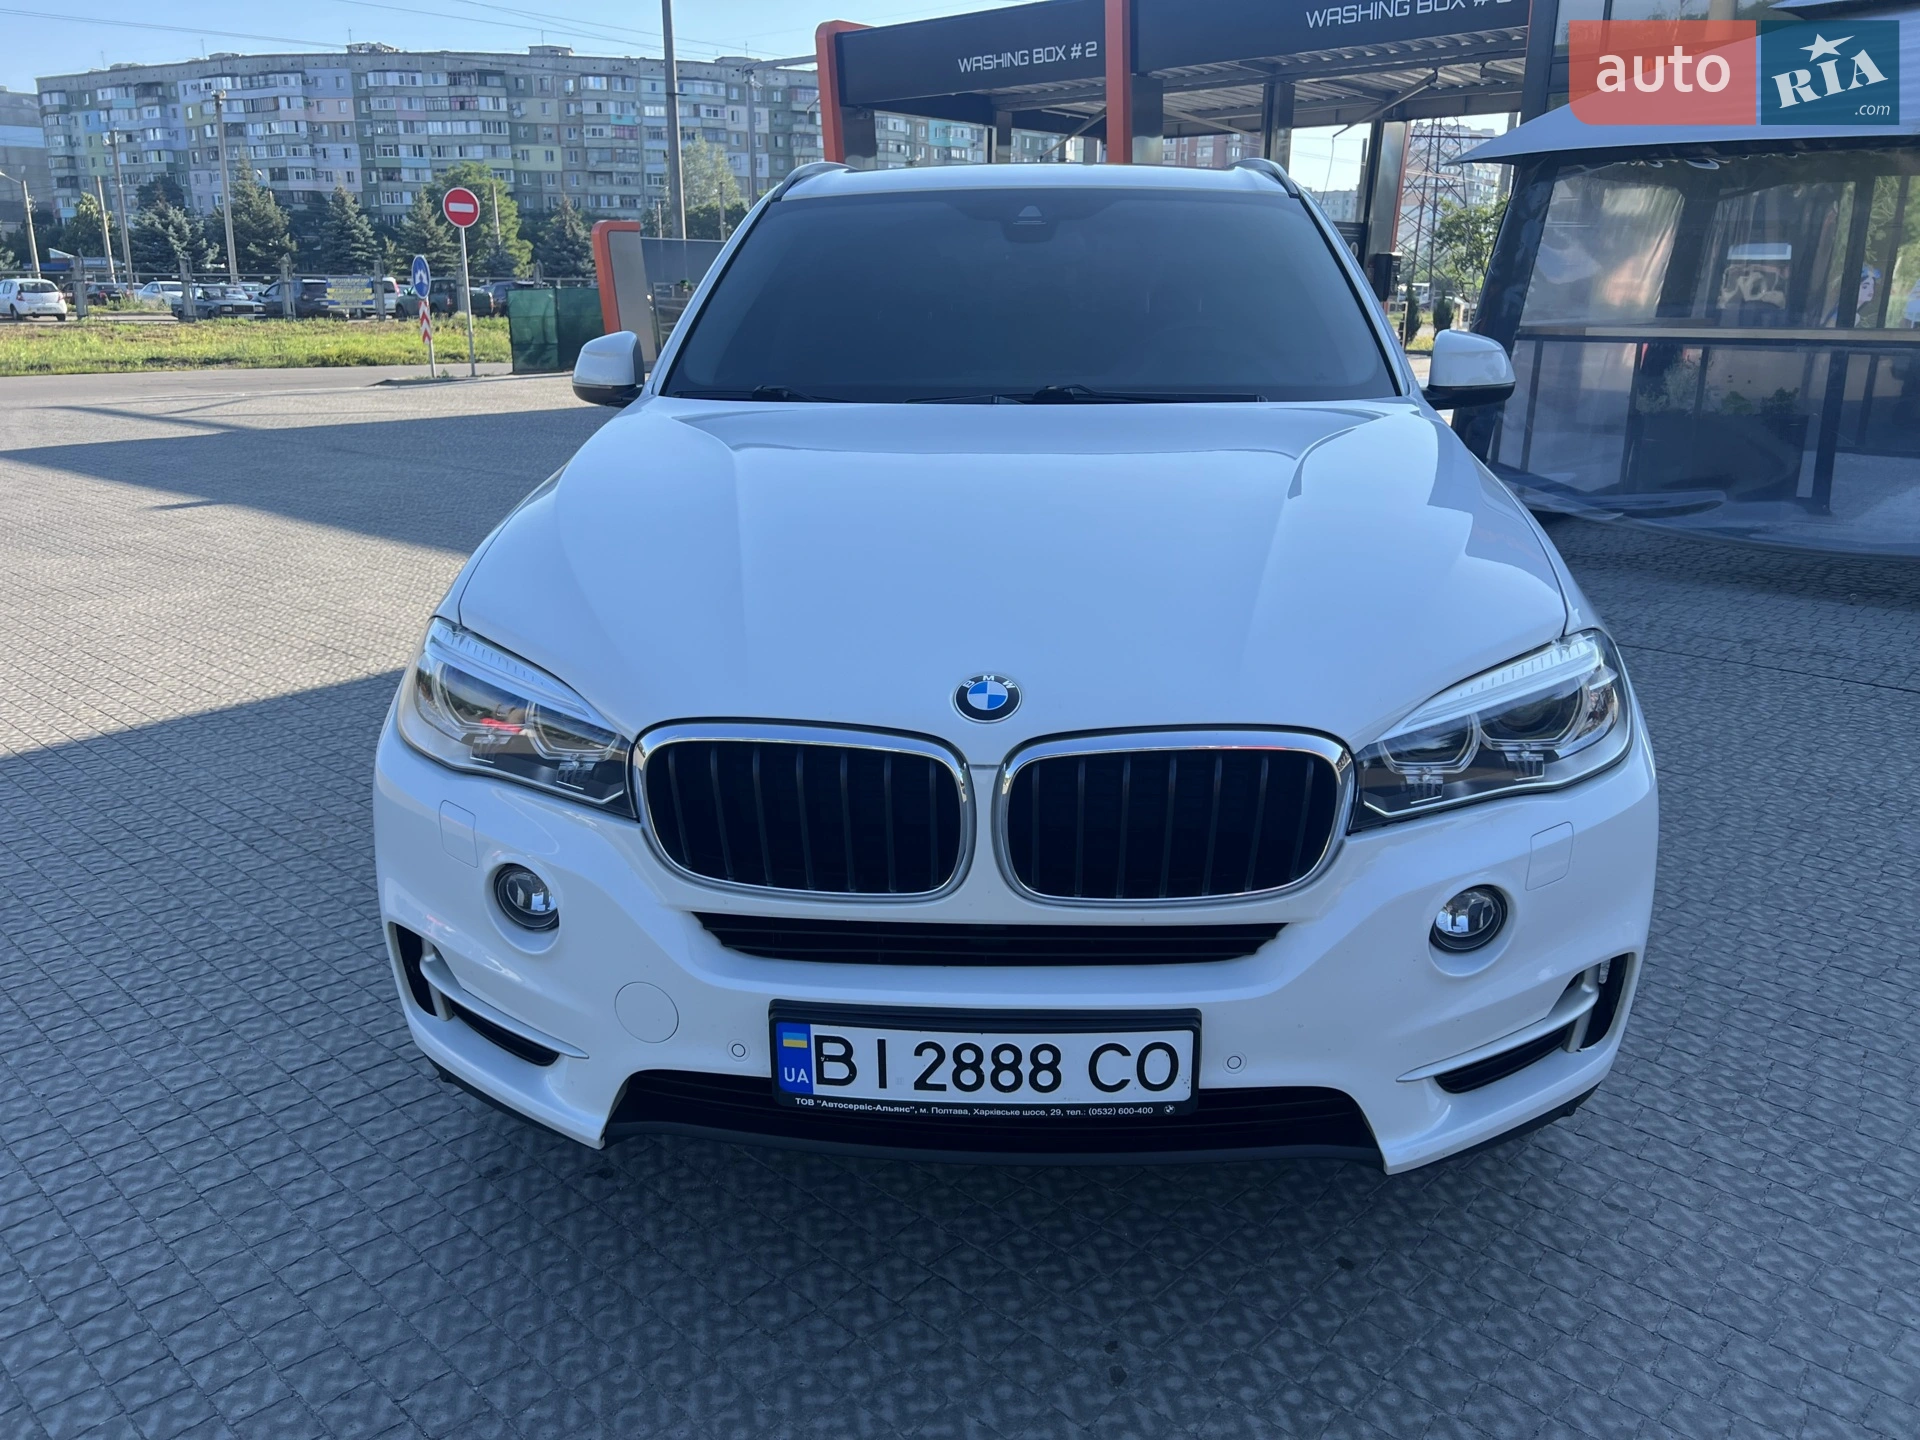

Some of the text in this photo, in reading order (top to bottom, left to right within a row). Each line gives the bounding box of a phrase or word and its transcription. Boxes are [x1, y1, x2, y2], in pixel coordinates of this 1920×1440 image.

[1306, 0, 1410, 29] WASHING
[958, 50, 1029, 73] WASHING
[1033, 45, 1066, 64] BOX
[1085, 41, 1097, 57] 2
[962, 675, 1016, 689] BMW
[784, 1067, 809, 1084] UA
[814, 1034, 1179, 1093] BI 2888 CO
[794, 1097, 815, 1106] ТОВ
[931, 1106, 971, 1116] Полтава,
[973, 1108, 1020, 1117] Харківське
[1022, 1109, 1048, 1117] шосе,
[1050, 1108, 1064, 1117] 29,
[1088, 1107, 1117, 1116] (0532)
[1118, 1106, 1153, 1115] 600-400
